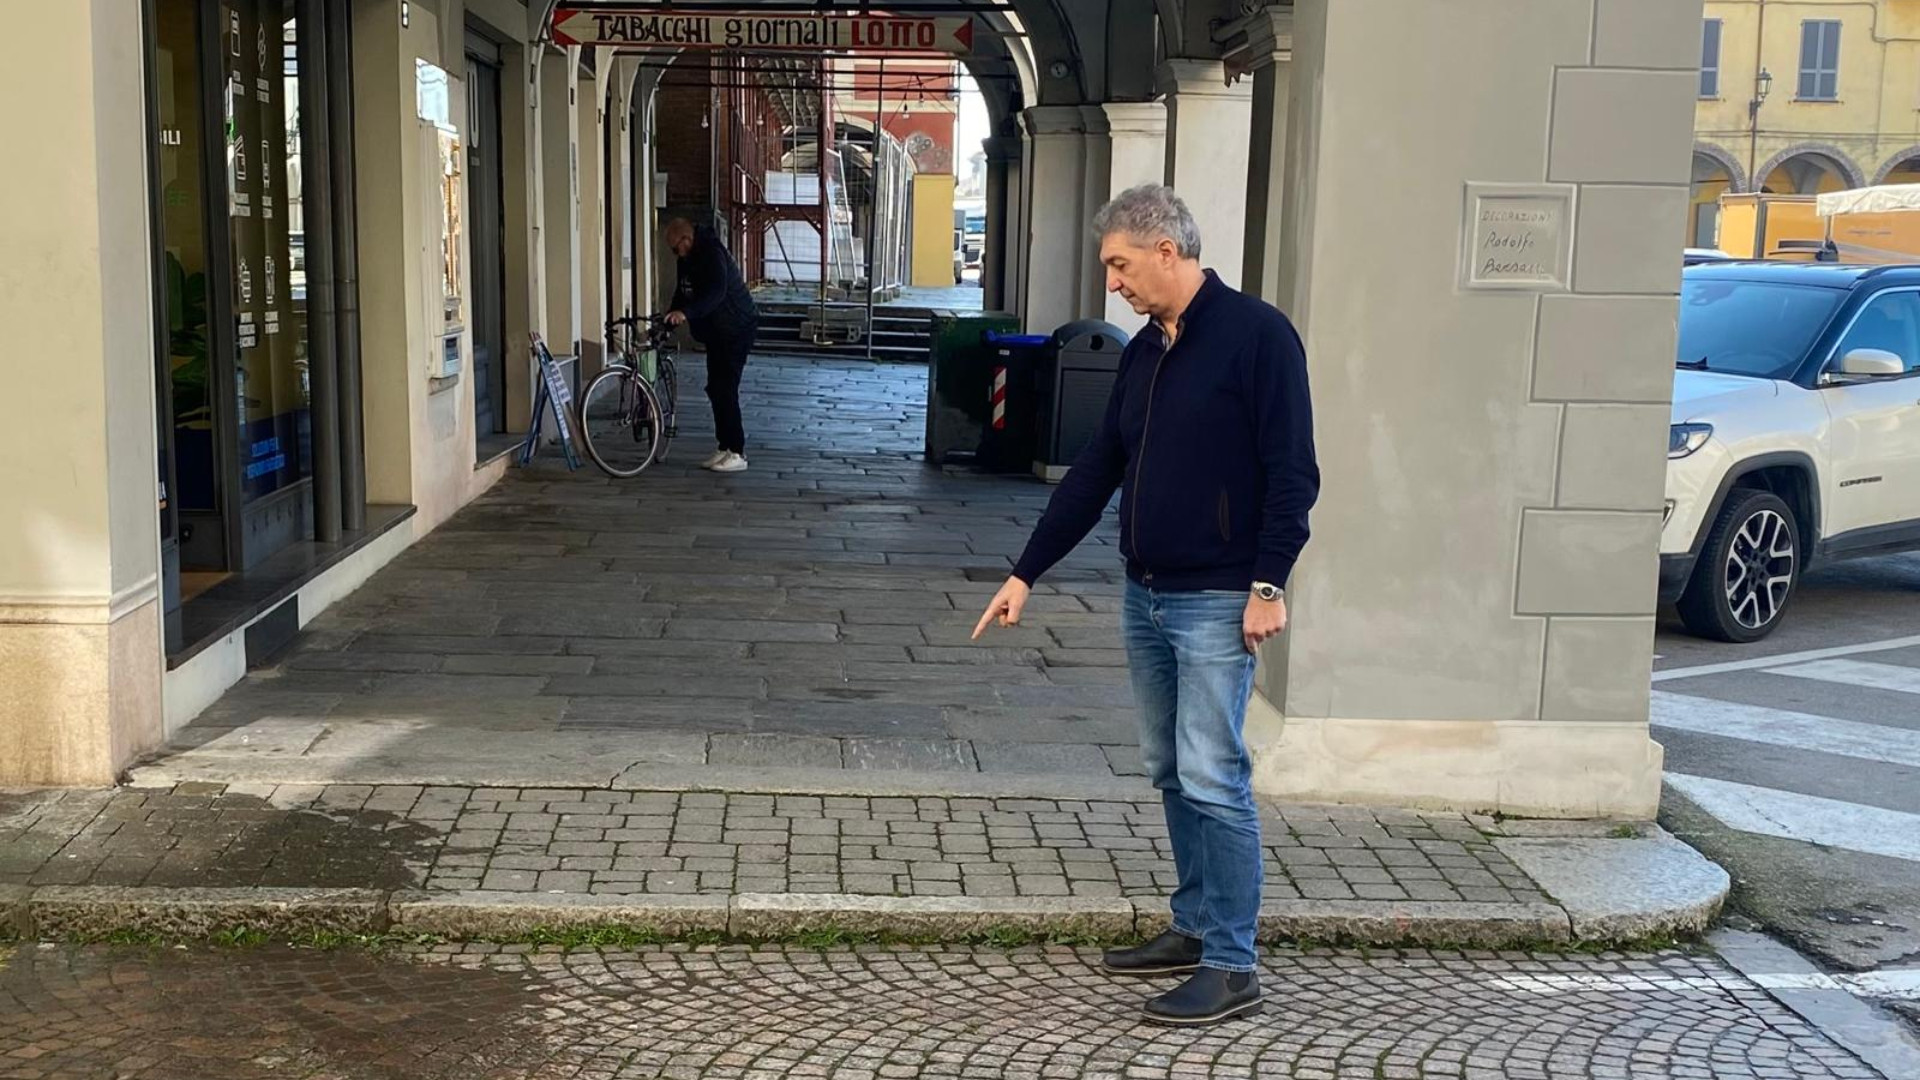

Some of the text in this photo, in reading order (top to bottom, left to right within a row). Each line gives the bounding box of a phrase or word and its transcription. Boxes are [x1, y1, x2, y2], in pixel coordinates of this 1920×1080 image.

[592, 15, 935, 48] TABACCHI giornali LOTTO
[159, 130, 180, 145] ILI
